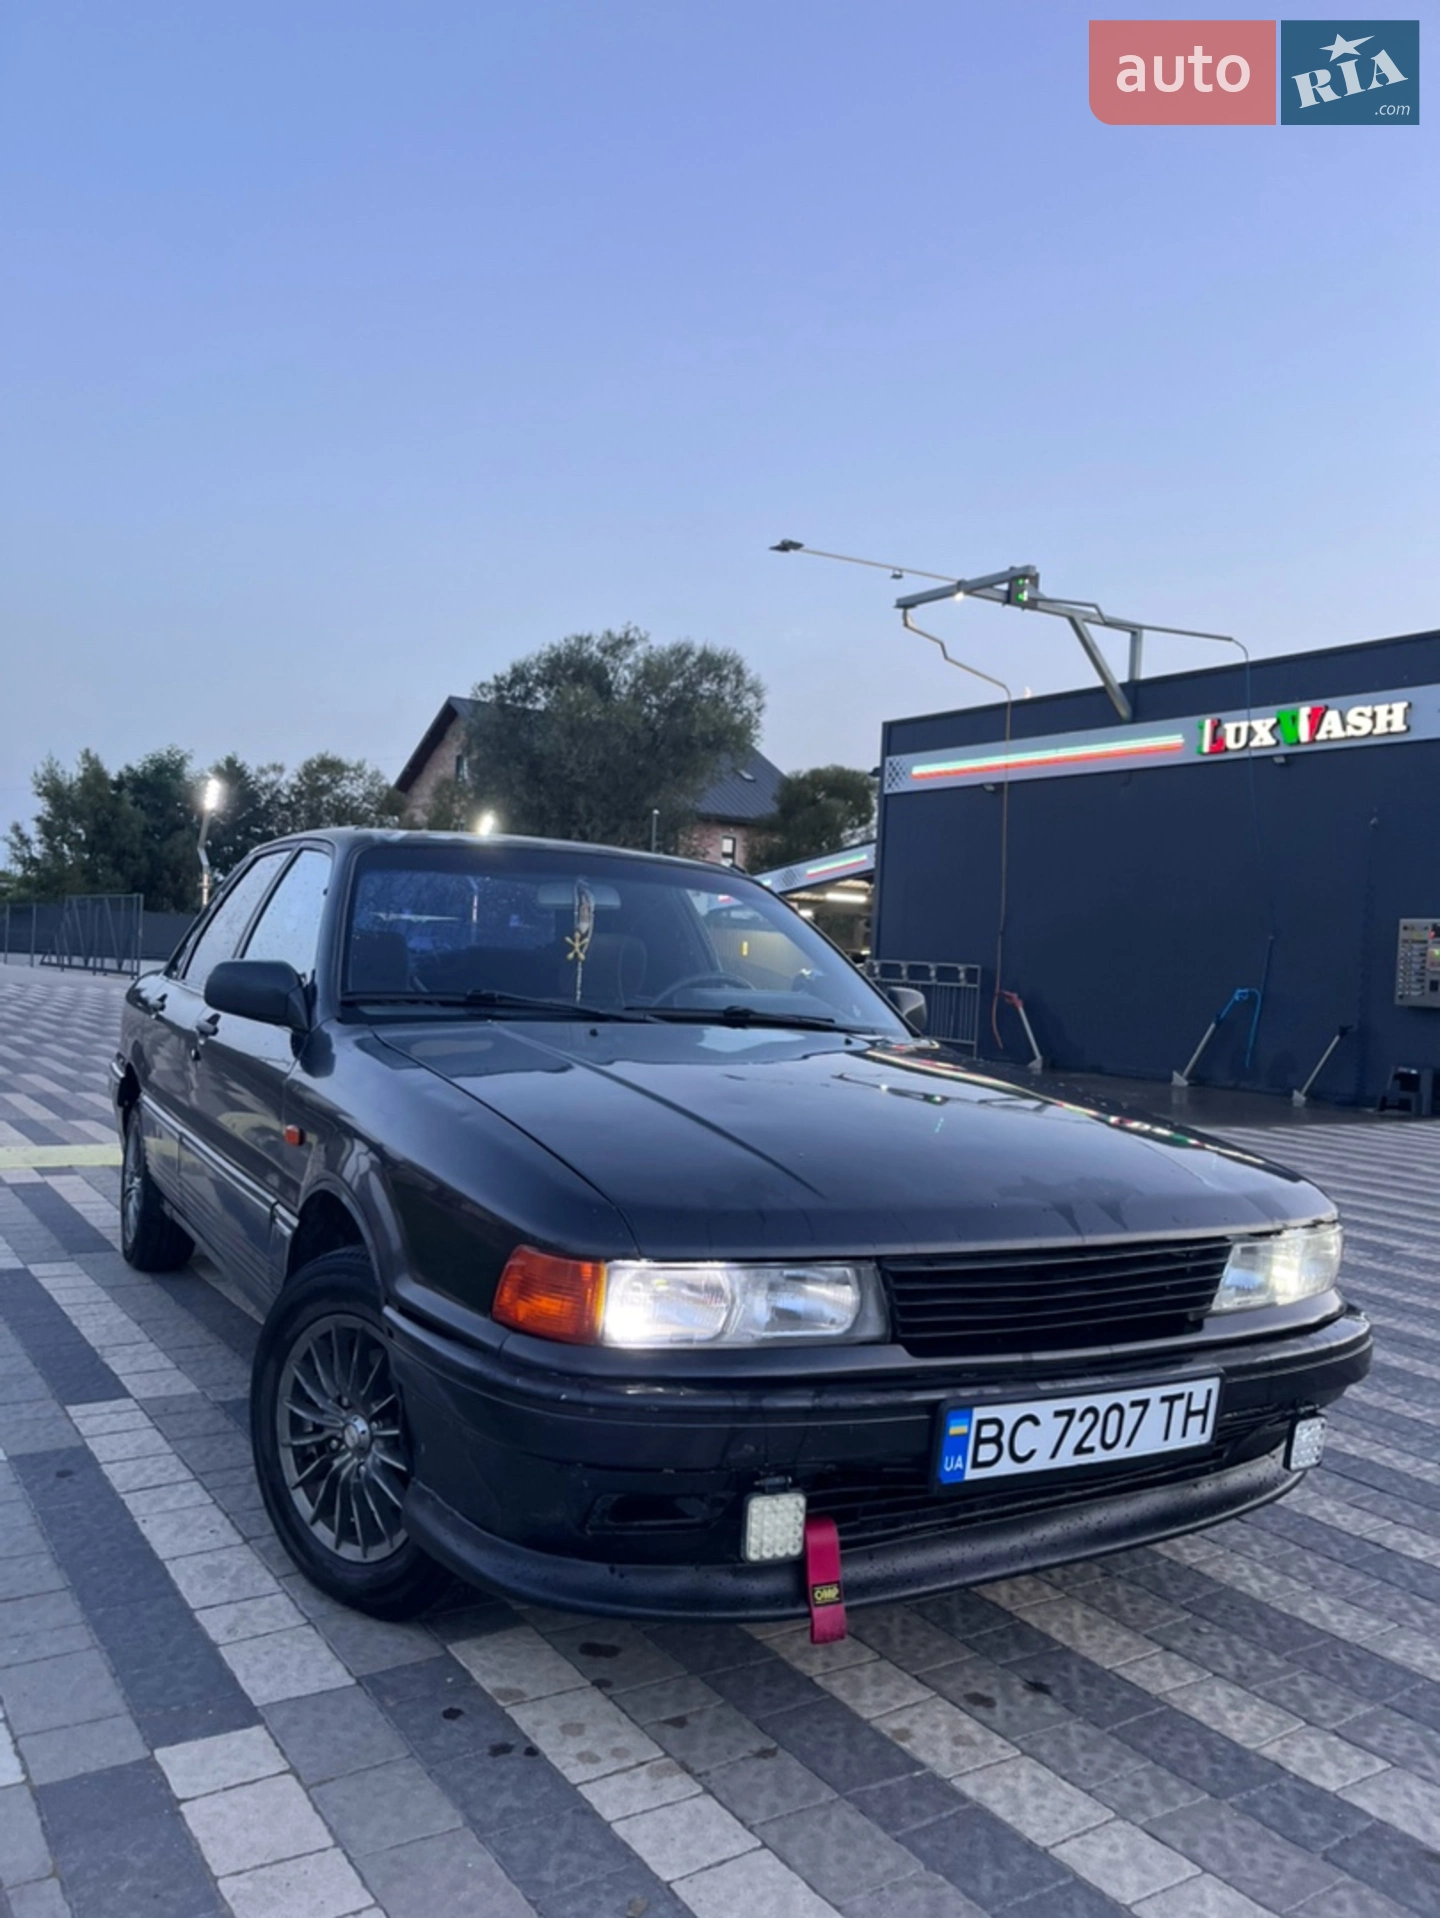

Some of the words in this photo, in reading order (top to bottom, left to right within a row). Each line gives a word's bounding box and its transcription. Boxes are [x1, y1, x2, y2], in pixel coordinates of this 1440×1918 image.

[970, 1414, 1041, 1470] BC
[1049, 1398, 1151, 1460] 7207
[1160, 1388, 1213, 1442] TH
[943, 1455, 964, 1472] UA
[813, 1586, 840, 1602] OMP
